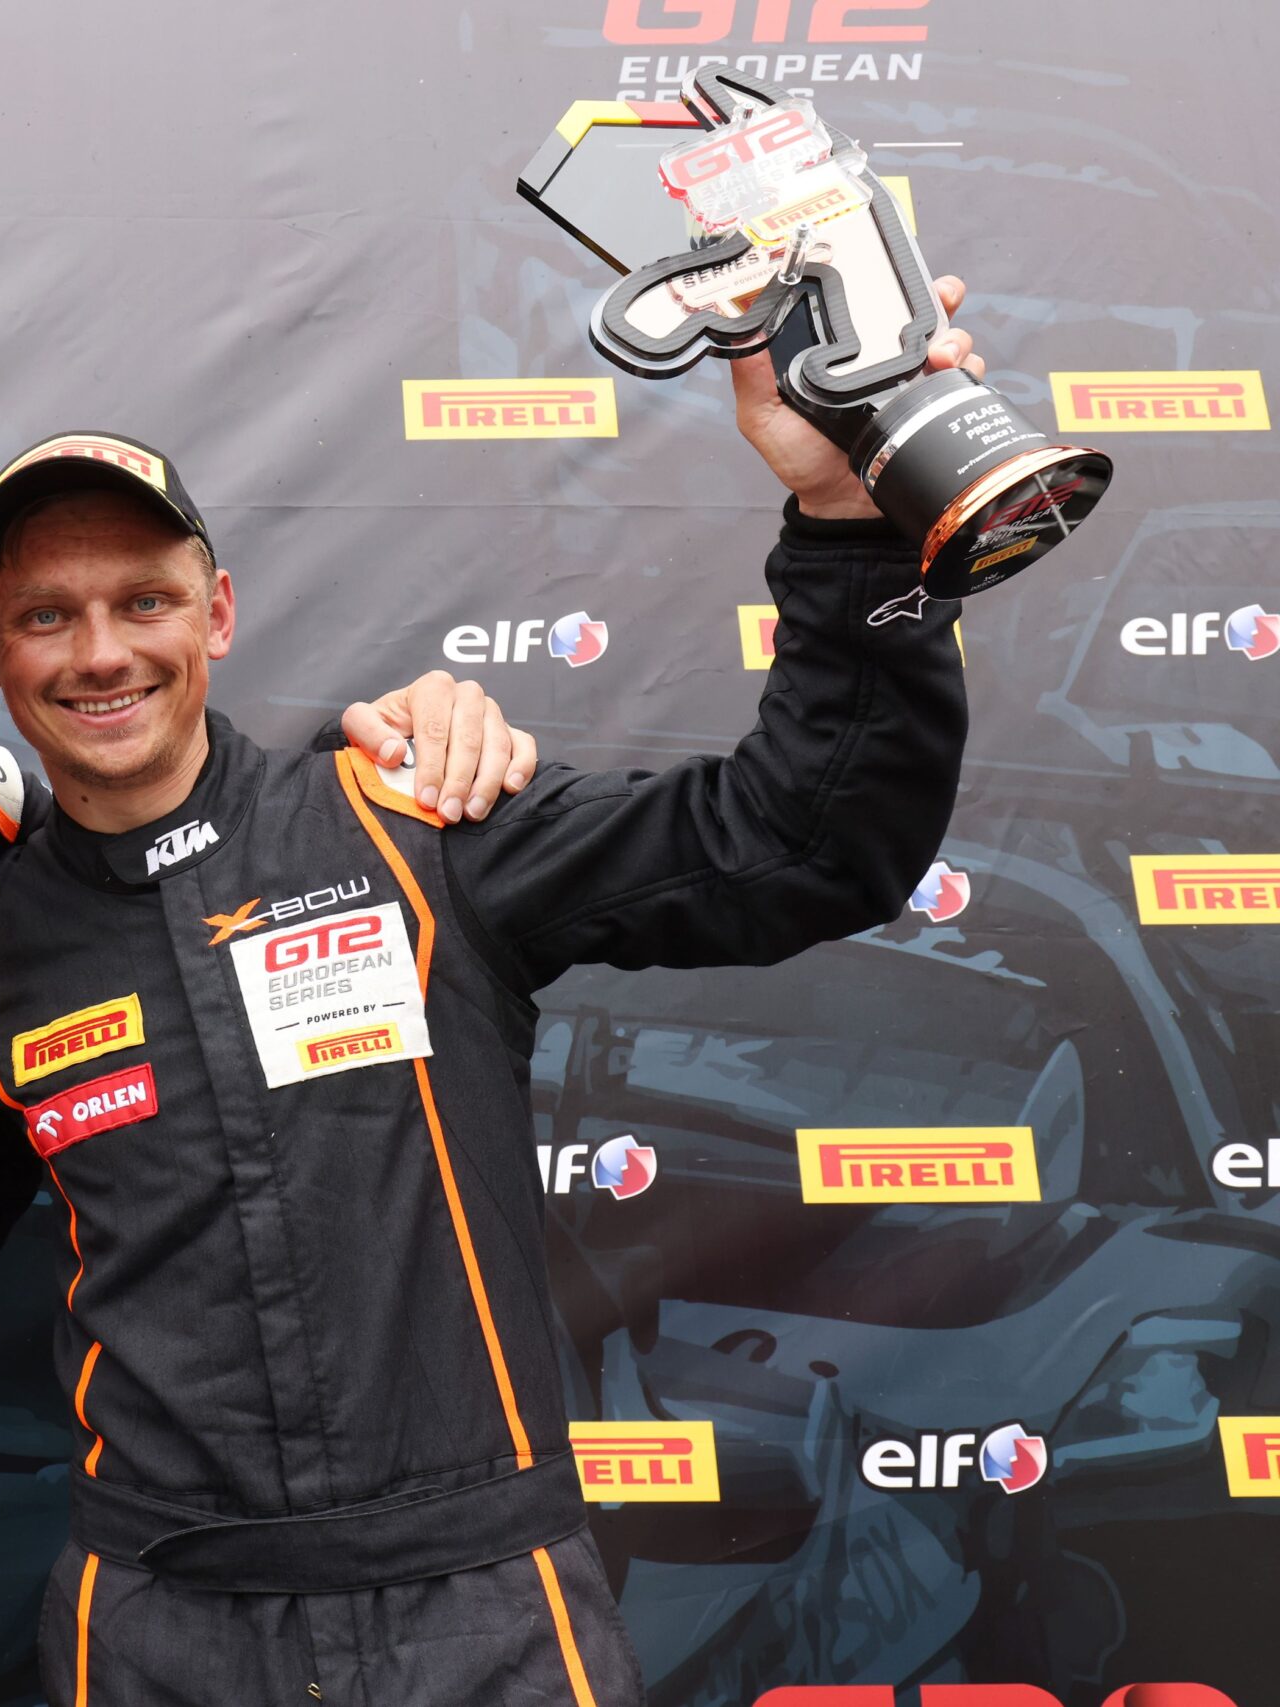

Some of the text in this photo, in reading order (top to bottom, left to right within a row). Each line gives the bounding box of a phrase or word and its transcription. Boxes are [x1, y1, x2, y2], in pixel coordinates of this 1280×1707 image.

[670, 110, 813, 187] GT2
[763, 188, 847, 230] PIRELLI
[420, 390, 597, 428] PIRELLI
[963, 403, 1006, 425] PLACE
[1069, 383, 1247, 420] PIRELLI
[965, 415, 1012, 440] PRO-AM
[980, 428, 1009, 446] Race
[442, 620, 545, 663] elf
[1120, 612, 1220, 656] elf
[145, 819, 220, 877] KTM
[264, 915, 384, 974] GT2
[268, 950, 393, 993] EUROPEAN
[269, 978, 353, 1011] SERIES
[306, 1003, 377, 1025] POWERED BY
[24, 1009, 127, 1070] PIRELLI
[306, 1028, 393, 1064] PIRELLI
[72, 1081, 147, 1123] ORLEN
[537, 1144, 588, 1194] lf
[818, 1142, 1015, 1188] PIRELLI
[861, 1433, 976, 1488] elf
